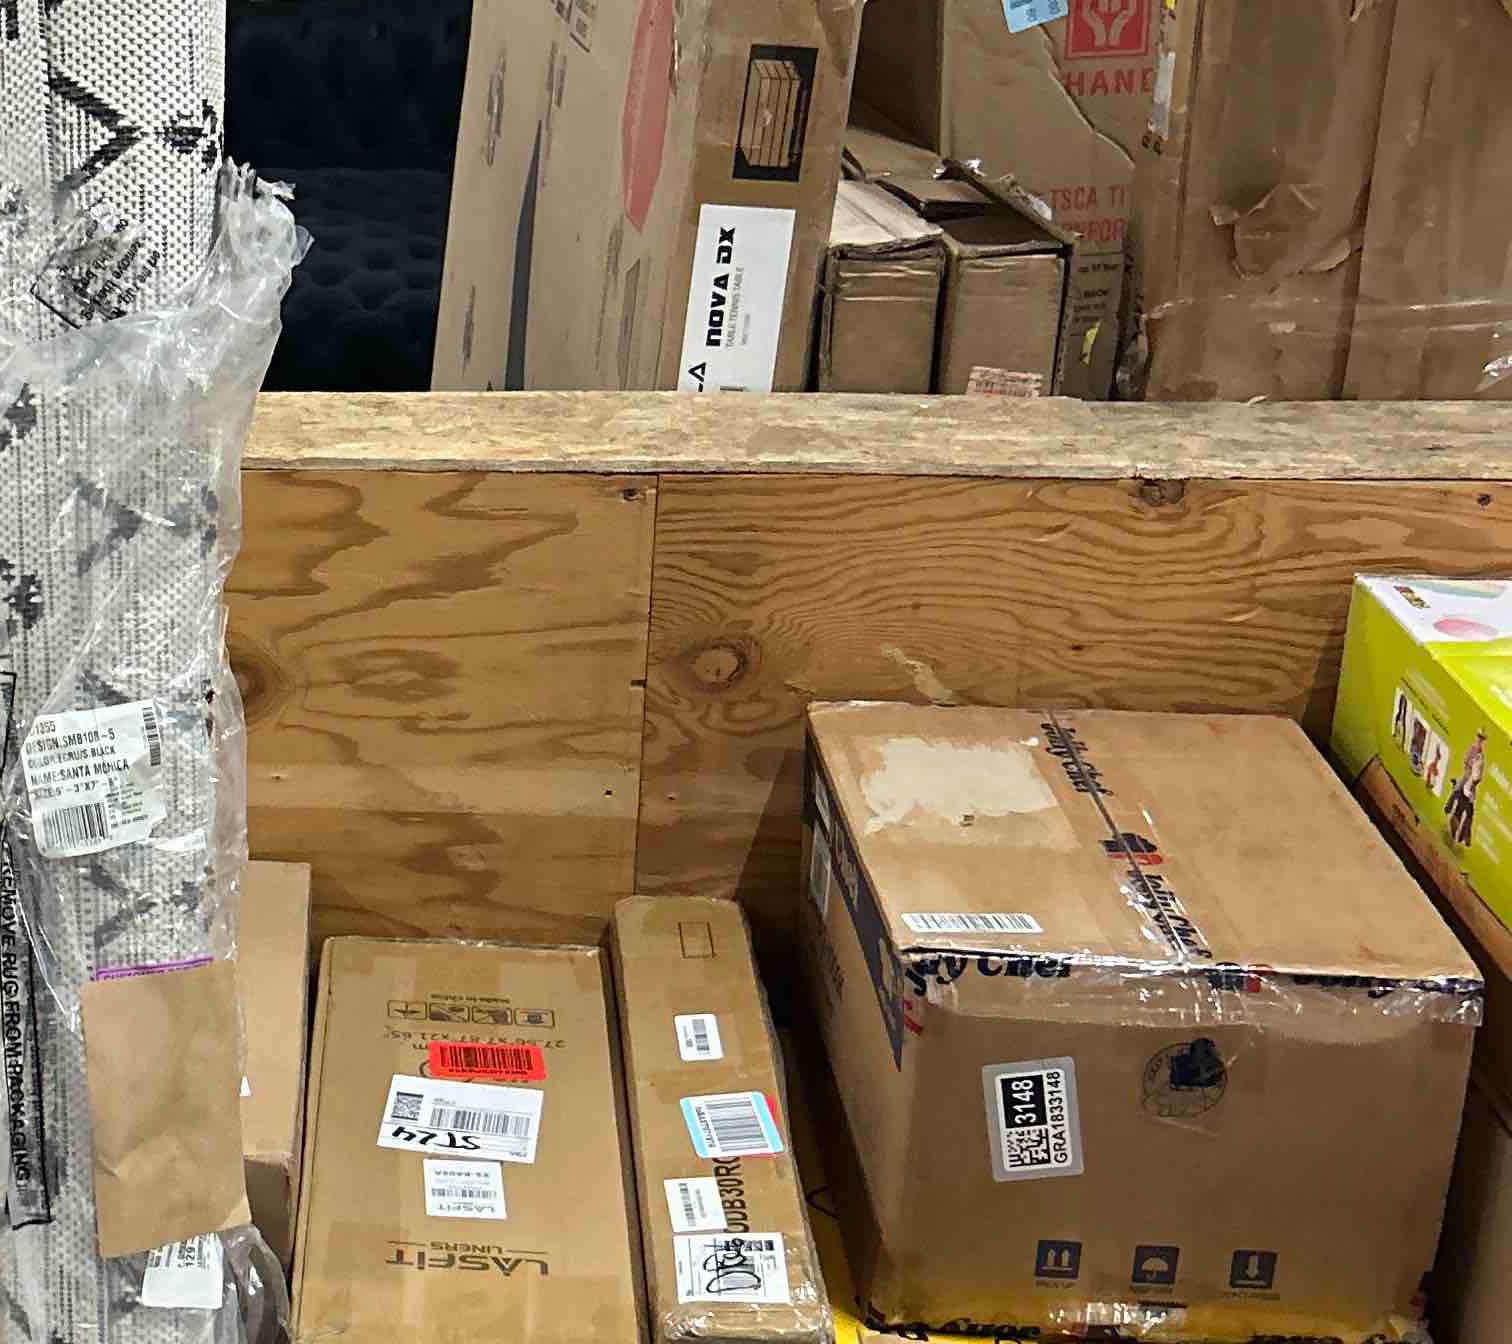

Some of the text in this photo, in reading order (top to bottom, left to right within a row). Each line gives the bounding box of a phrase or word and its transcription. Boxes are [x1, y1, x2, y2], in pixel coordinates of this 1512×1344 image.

[1014, 1078, 1038, 1124] 3148
[1046, 1069, 1071, 1165] GRA1833148
[385, 1248, 549, 1278] LASFIT
[429, 1241, 503, 1254] LINERS
